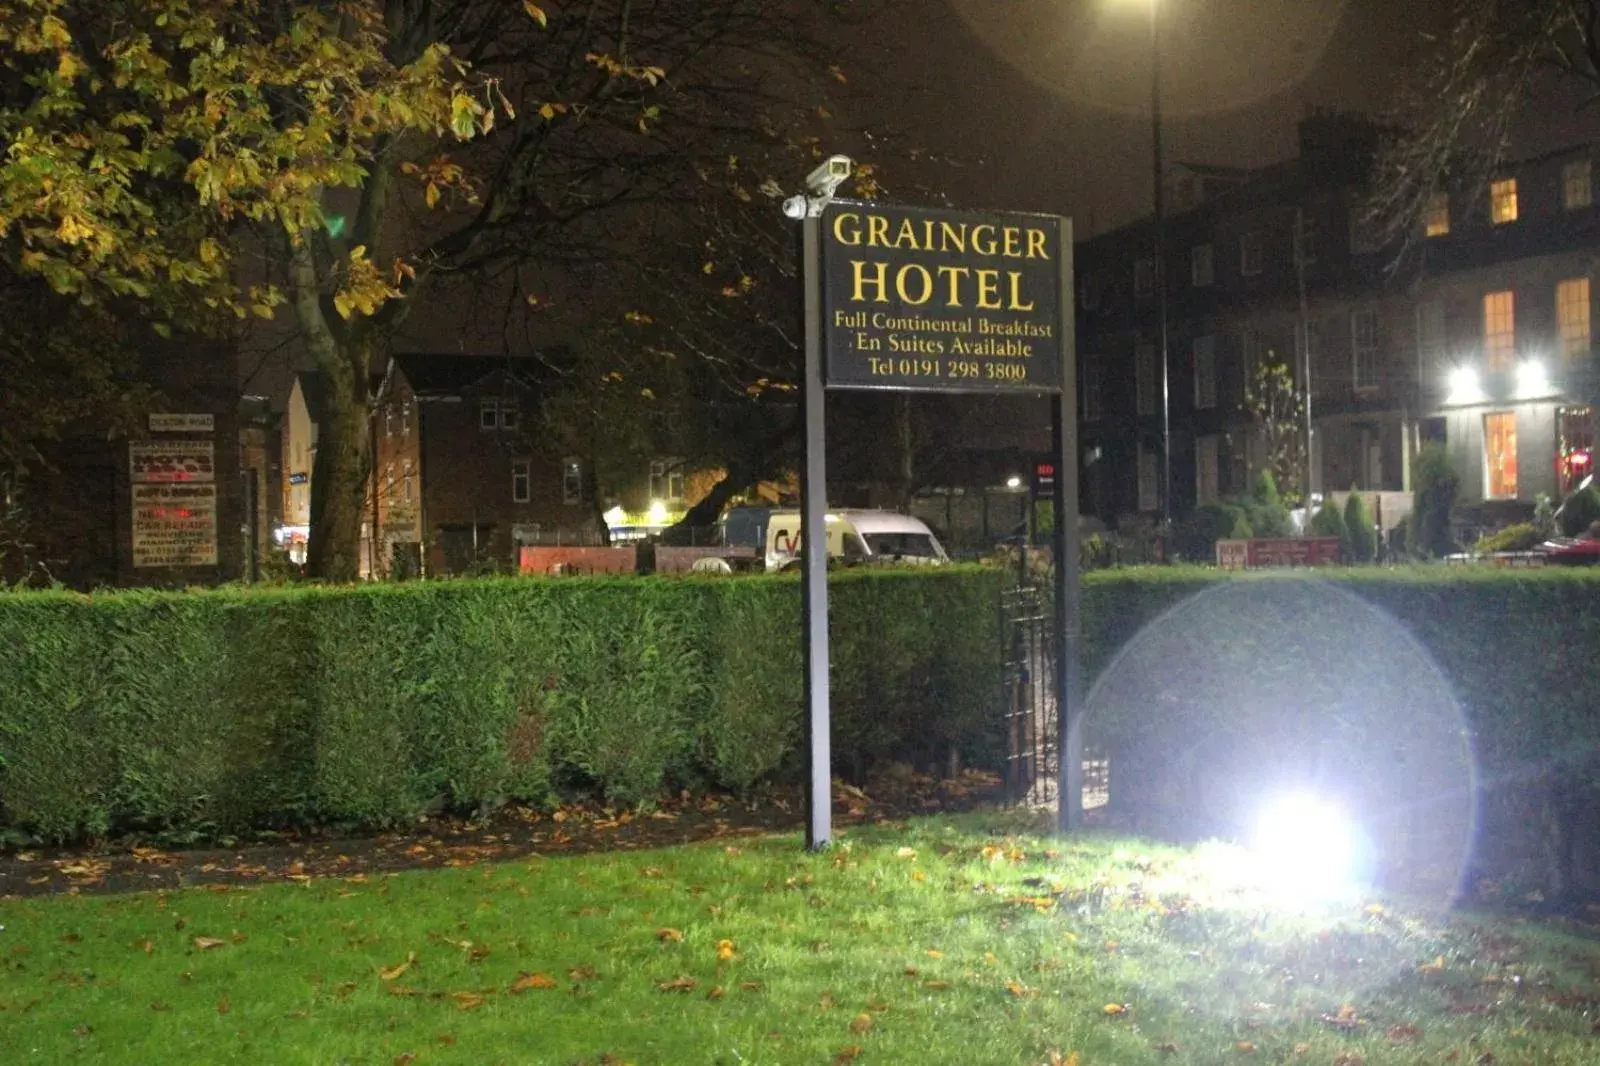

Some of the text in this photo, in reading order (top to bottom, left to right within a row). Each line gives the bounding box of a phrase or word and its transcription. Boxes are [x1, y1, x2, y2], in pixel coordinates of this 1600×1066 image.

[833, 212, 1051, 260] GRAINGER
[849, 260, 1034, 311] HOTEL
[835, 310, 1052, 338] Full Continental Breakfast
[855, 332, 1033, 358] En Suites Available
[868, 357, 1026, 380] Tel 0191 298 3800
